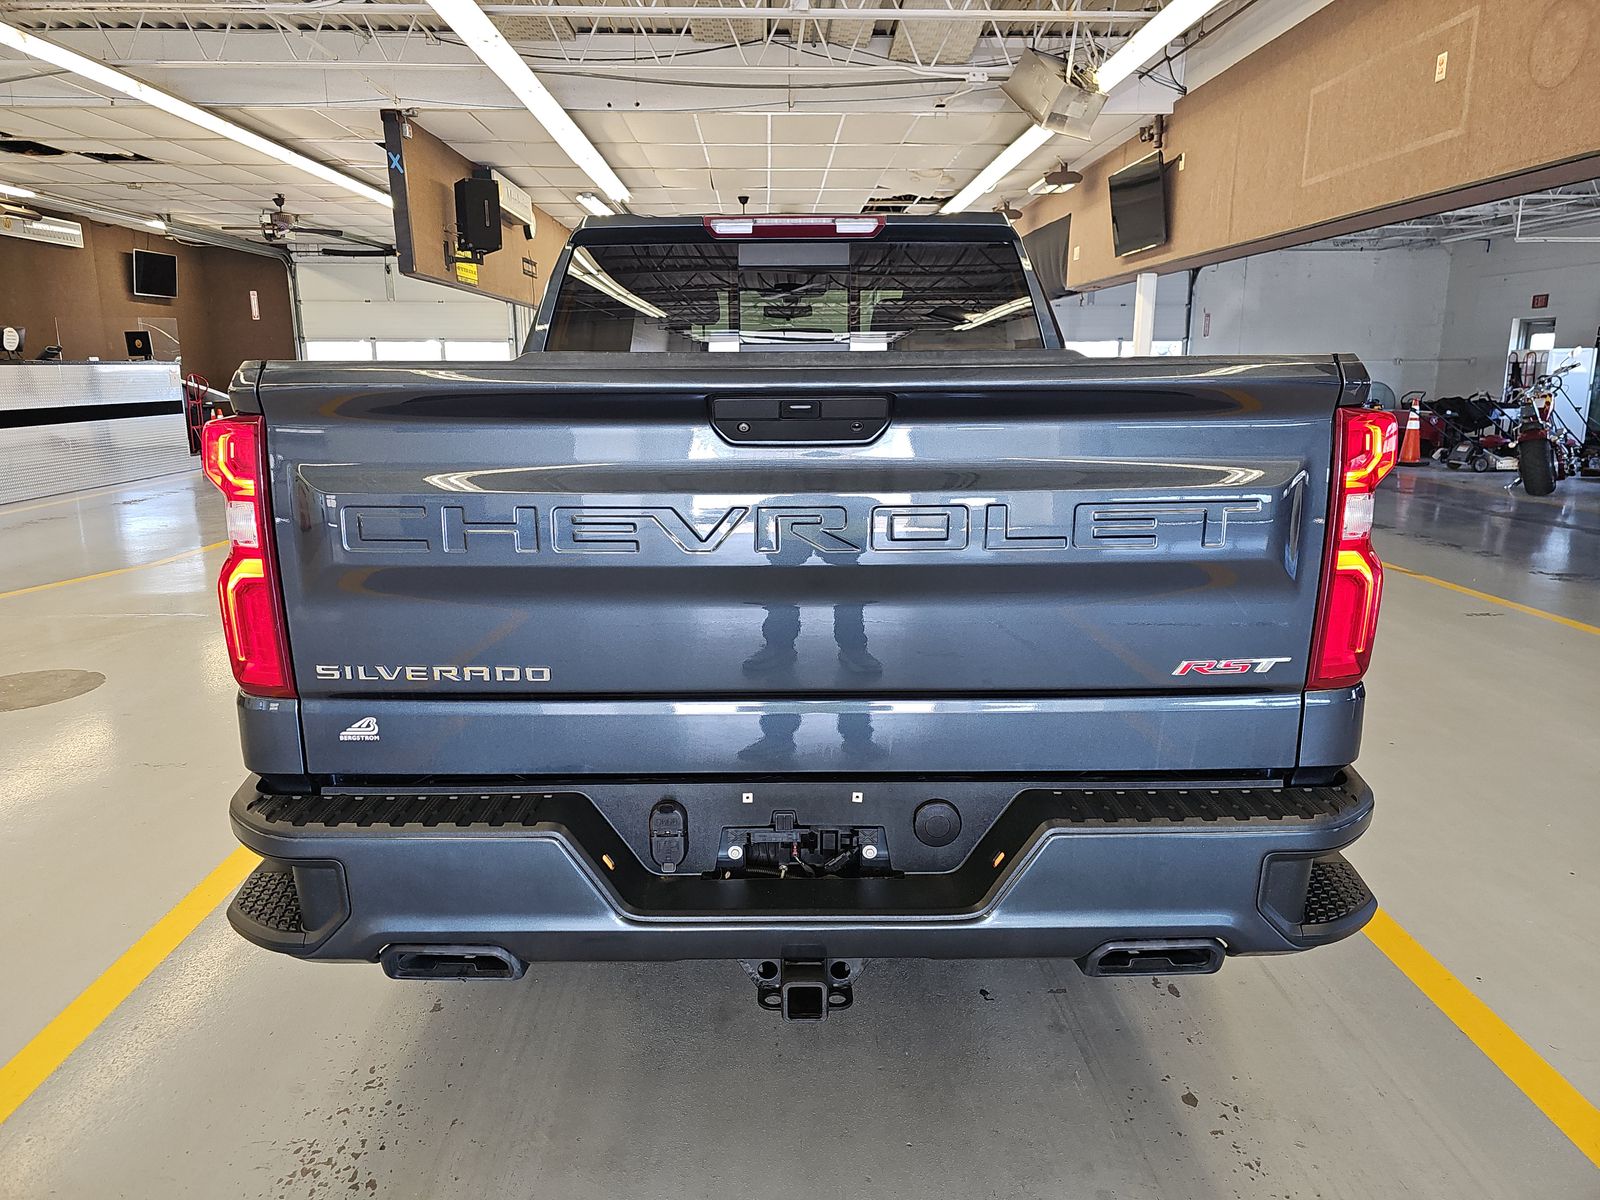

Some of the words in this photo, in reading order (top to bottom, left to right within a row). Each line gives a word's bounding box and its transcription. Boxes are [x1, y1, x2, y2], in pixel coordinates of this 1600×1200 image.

[340, 499, 1263, 554] CHEVROLET
[315, 664, 552, 682] SILVERADO
[1171, 656, 1292, 675] RST
